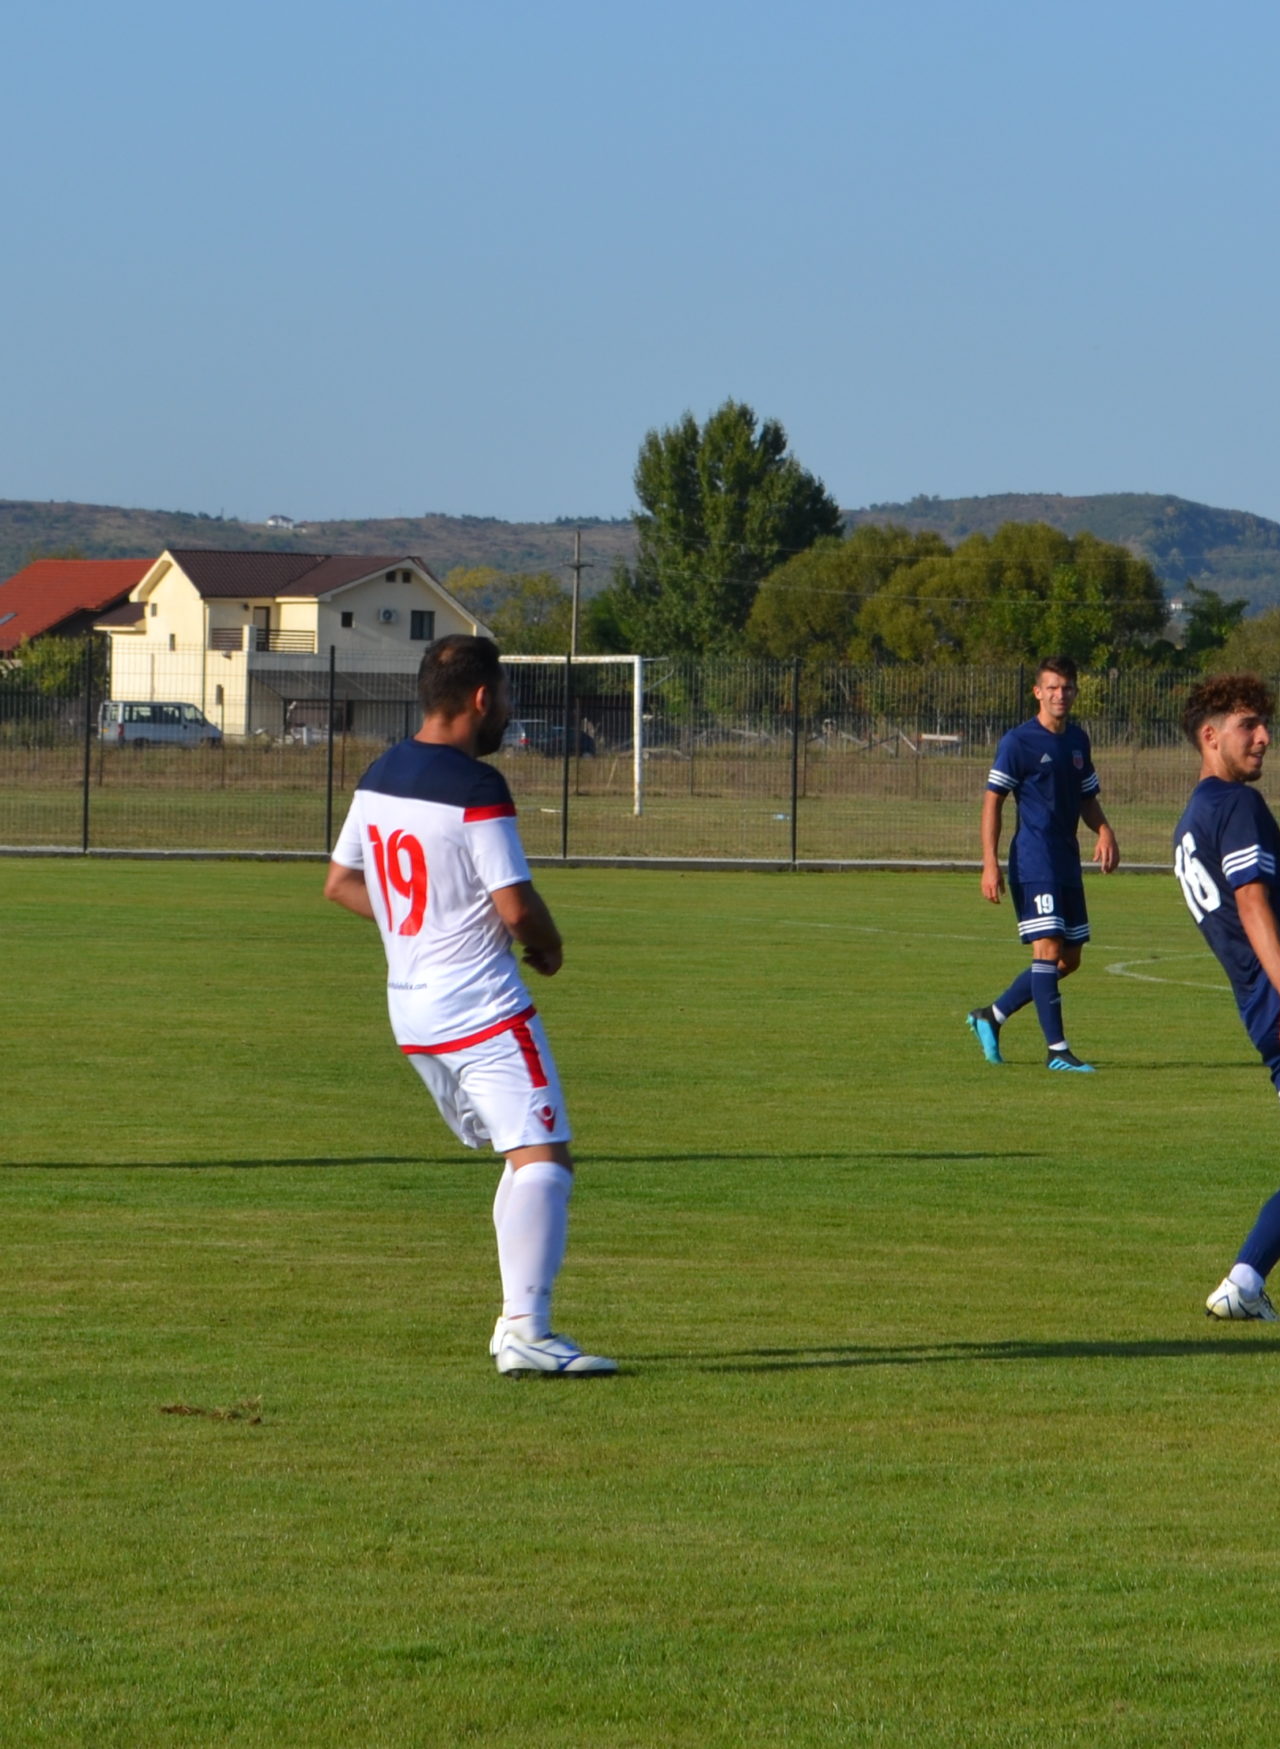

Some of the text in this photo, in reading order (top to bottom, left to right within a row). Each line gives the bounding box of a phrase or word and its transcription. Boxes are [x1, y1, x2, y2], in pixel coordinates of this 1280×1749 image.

[367, 824, 428, 936] 19
[1034, 893, 1055, 915] 19
[1174, 831, 1222, 925] 16
